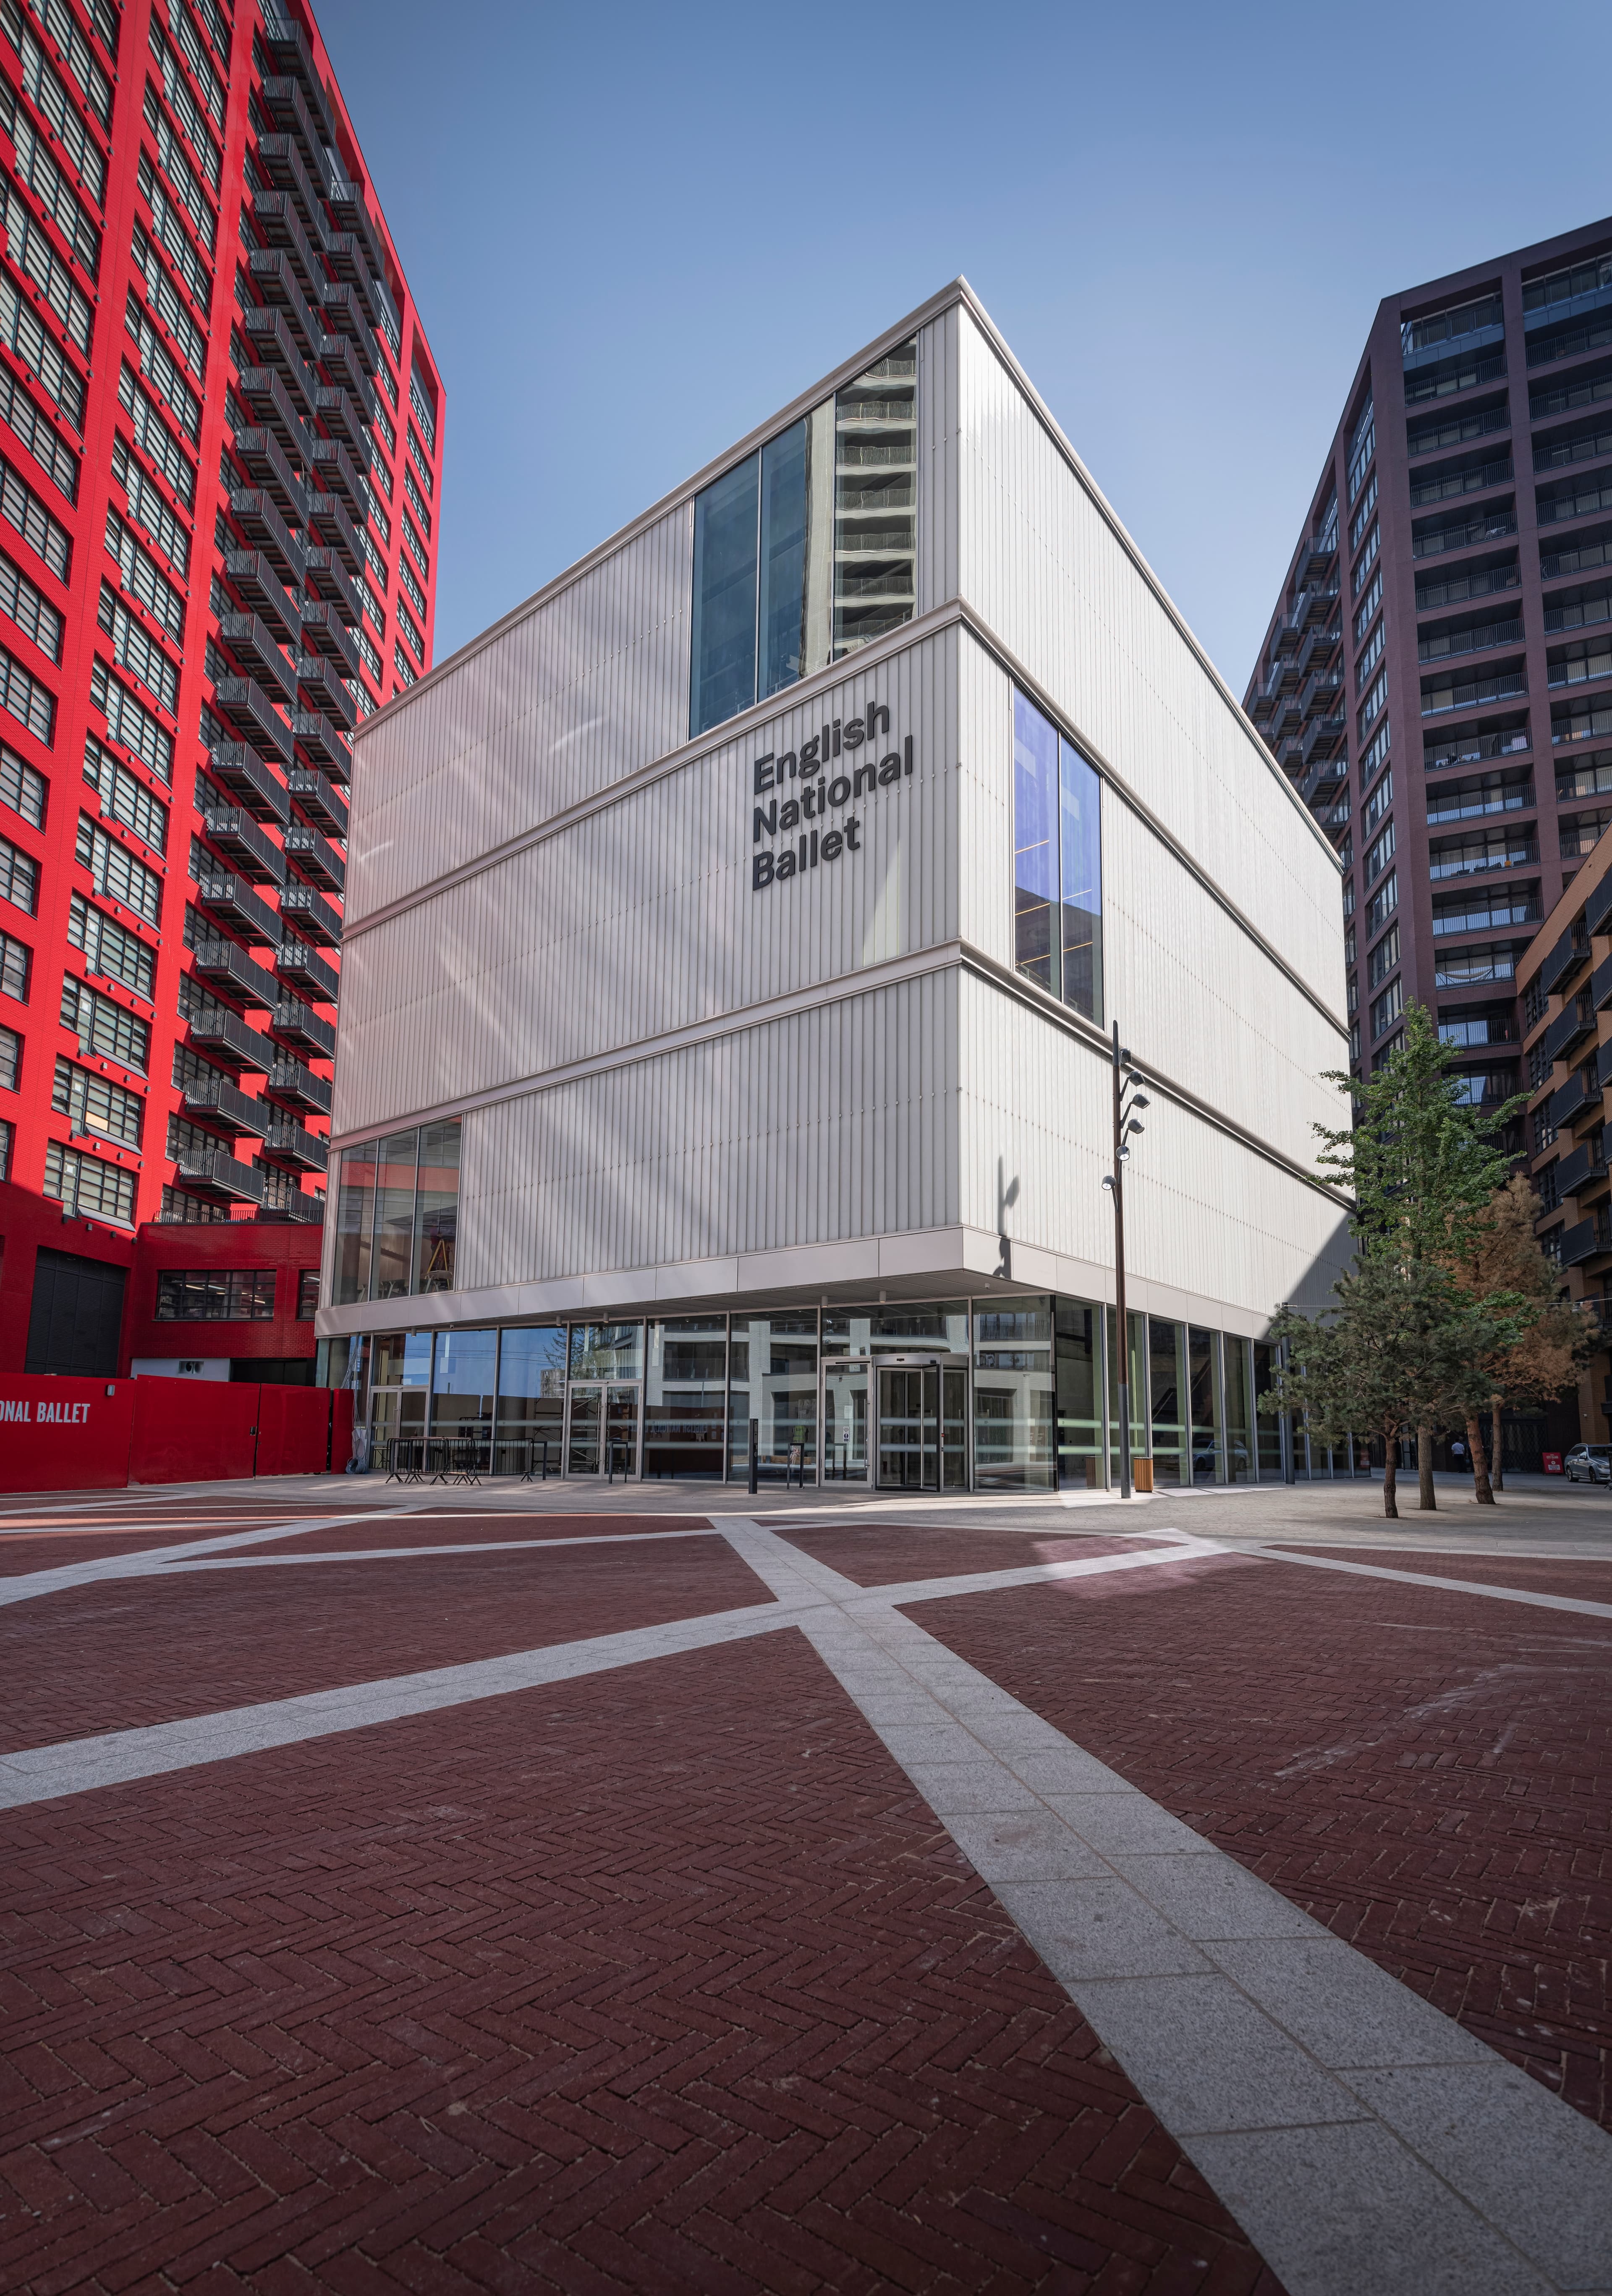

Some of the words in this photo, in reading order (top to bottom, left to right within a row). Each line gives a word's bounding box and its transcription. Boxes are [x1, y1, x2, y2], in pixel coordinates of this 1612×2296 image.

[754, 701, 889, 795] English
[754, 735, 912, 843] National
[753, 816, 860, 890] Ballet
[37, 1402, 91, 1423] BALLET
